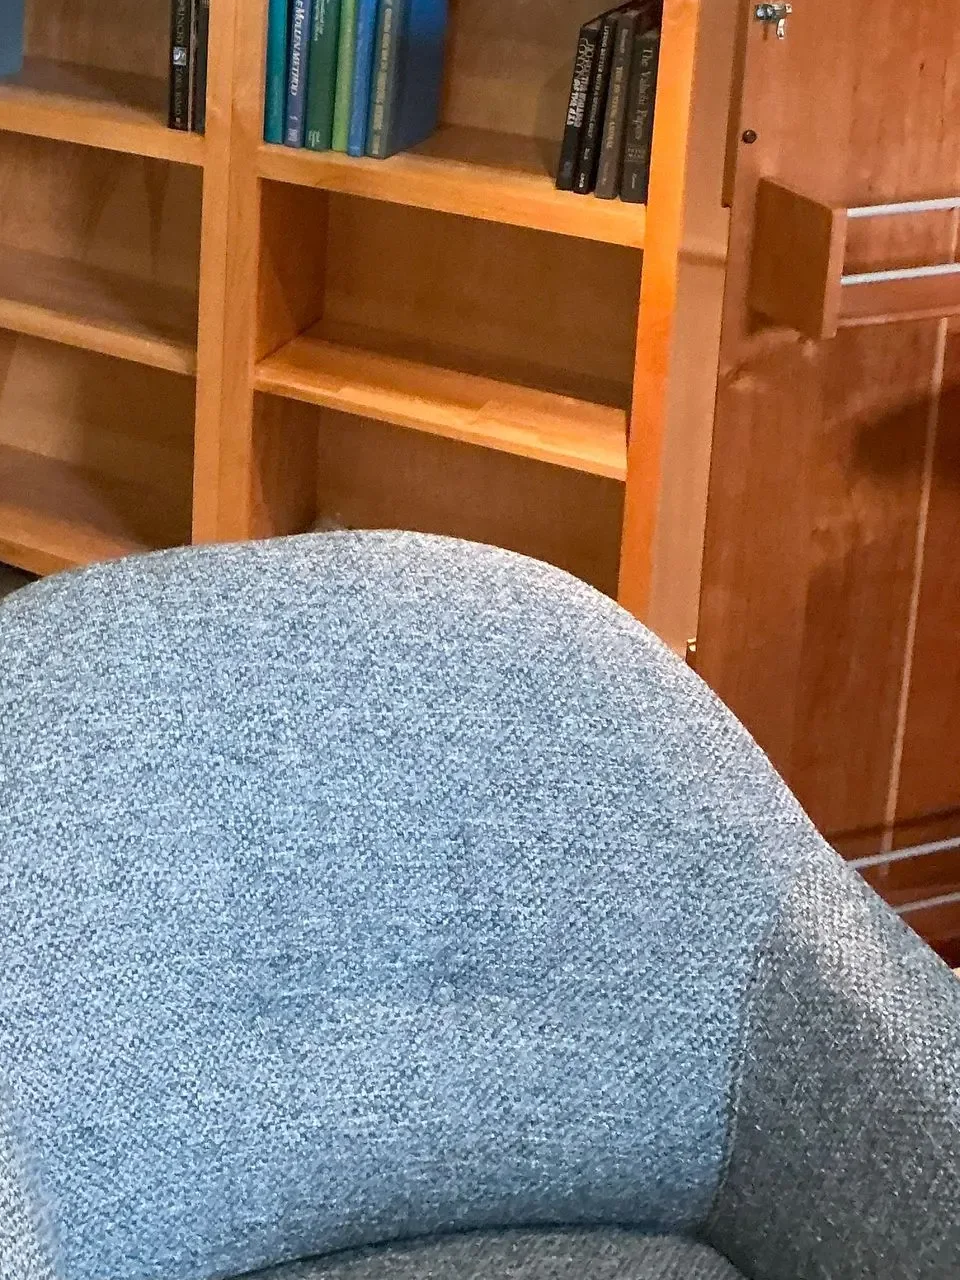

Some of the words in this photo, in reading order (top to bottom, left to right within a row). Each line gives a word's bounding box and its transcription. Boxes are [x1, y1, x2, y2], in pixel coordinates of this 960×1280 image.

[293, 8, 306, 50] MOLLEN
[290, 51, 301, 96] METHOD
[641, 48, 653, 67] The
